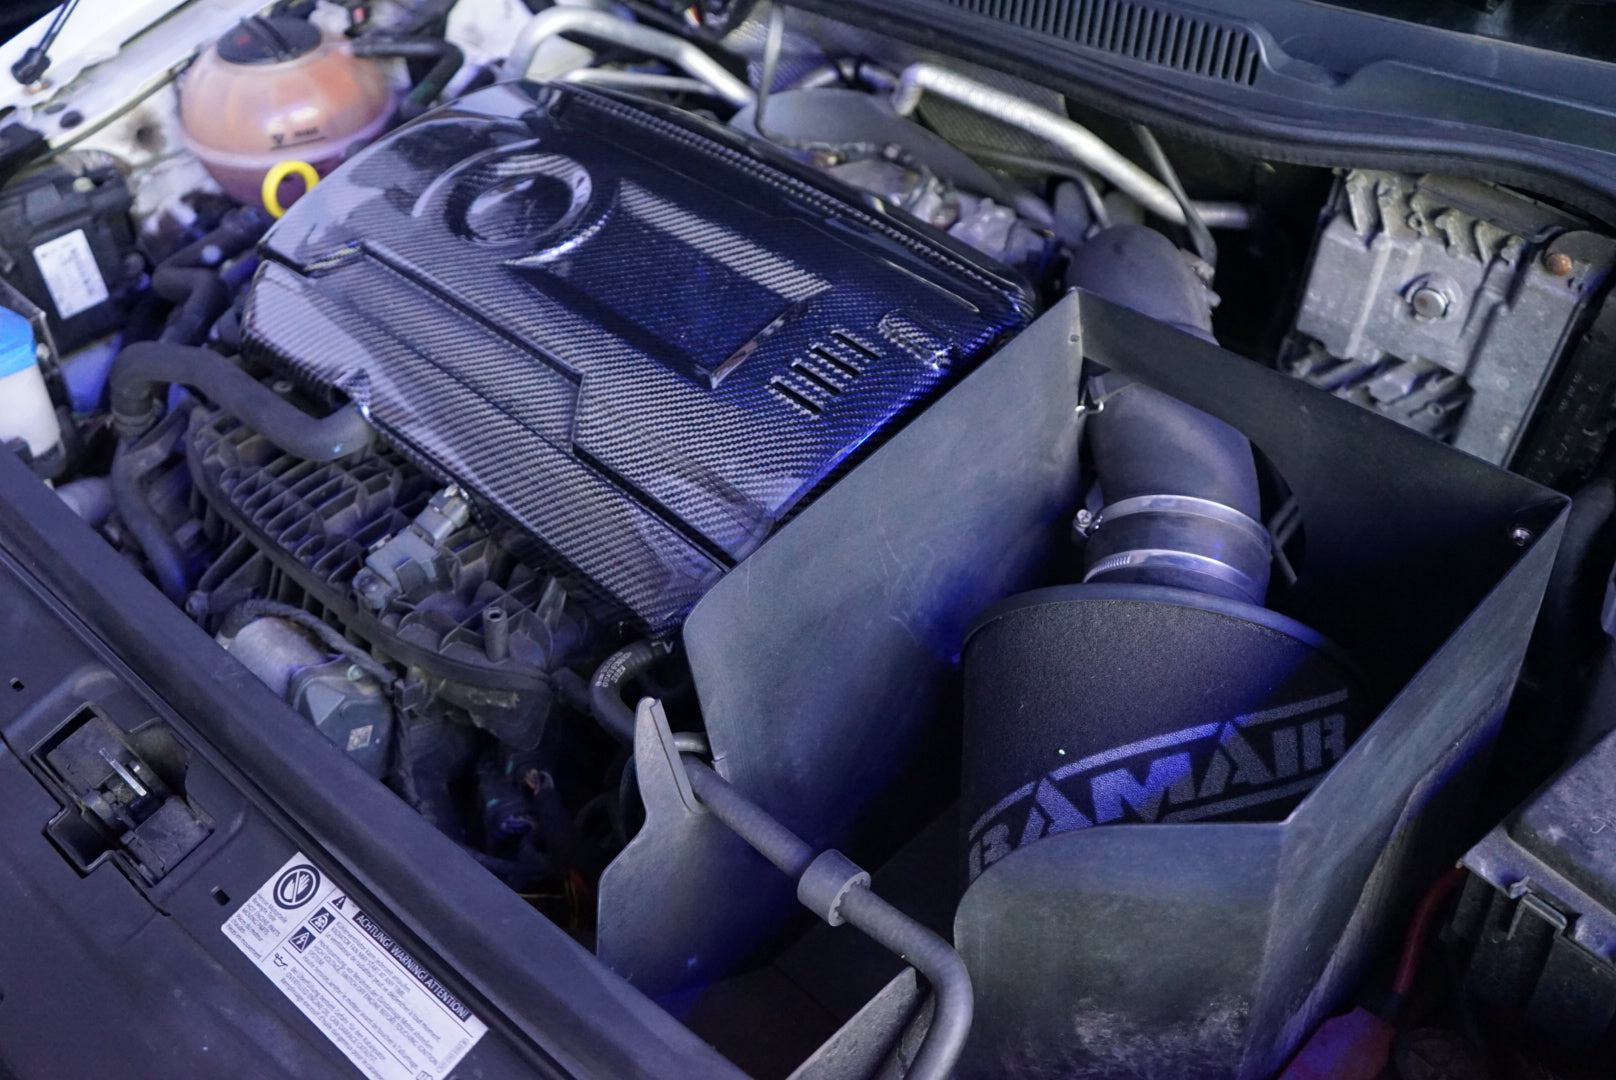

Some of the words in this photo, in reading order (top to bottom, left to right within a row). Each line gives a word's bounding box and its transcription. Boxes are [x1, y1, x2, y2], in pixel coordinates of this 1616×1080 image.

[348, 943, 360, 954] FAN
[356, 950, 369, 963] MAY
[365, 959, 381, 974] START
[383, 976, 395, 988] ANY
[354, 912, 394, 950] ACHTUNG!
[388, 944, 429, 982] WARNING!
[423, 976, 469, 1019] ATTENTION!
